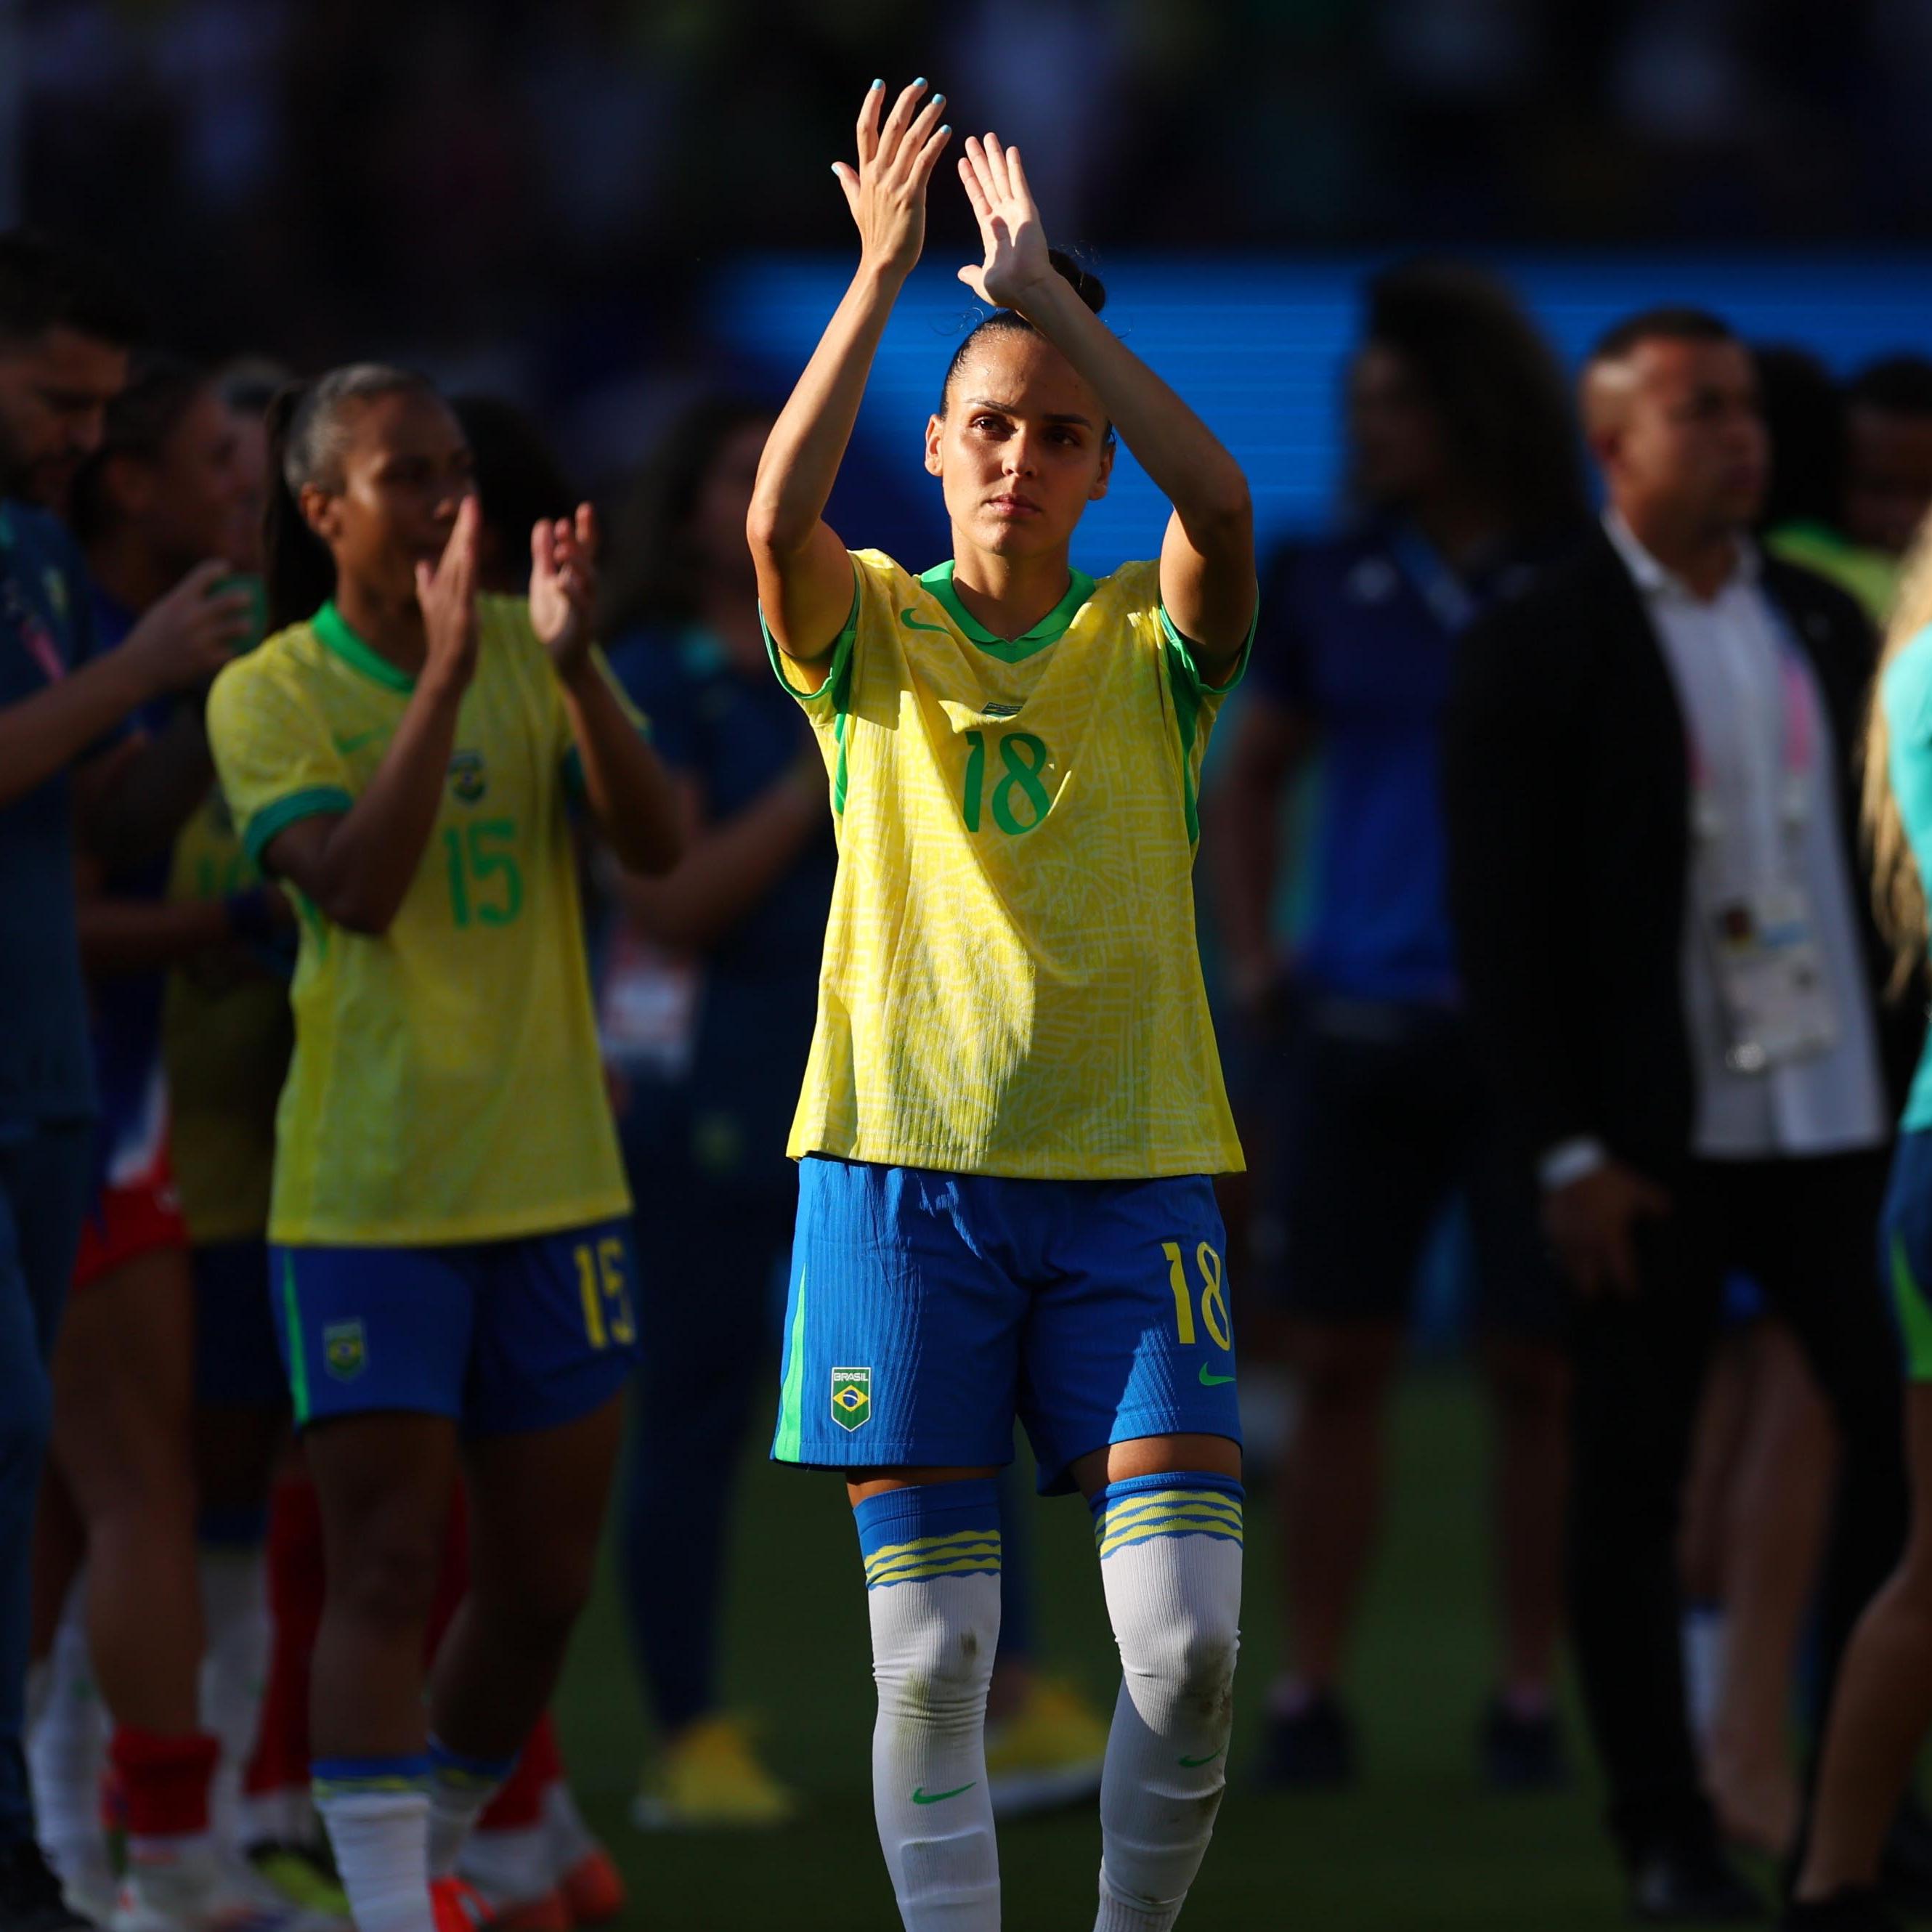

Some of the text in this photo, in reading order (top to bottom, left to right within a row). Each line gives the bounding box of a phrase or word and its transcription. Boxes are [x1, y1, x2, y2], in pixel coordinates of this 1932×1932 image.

[963, 731, 1050, 835] 18
[444, 818, 523, 928] 15
[575, 1239, 635, 1349] 15
[1161, 1241, 1230, 1351] 18
[833, 1372, 869, 1381] BRASIL
